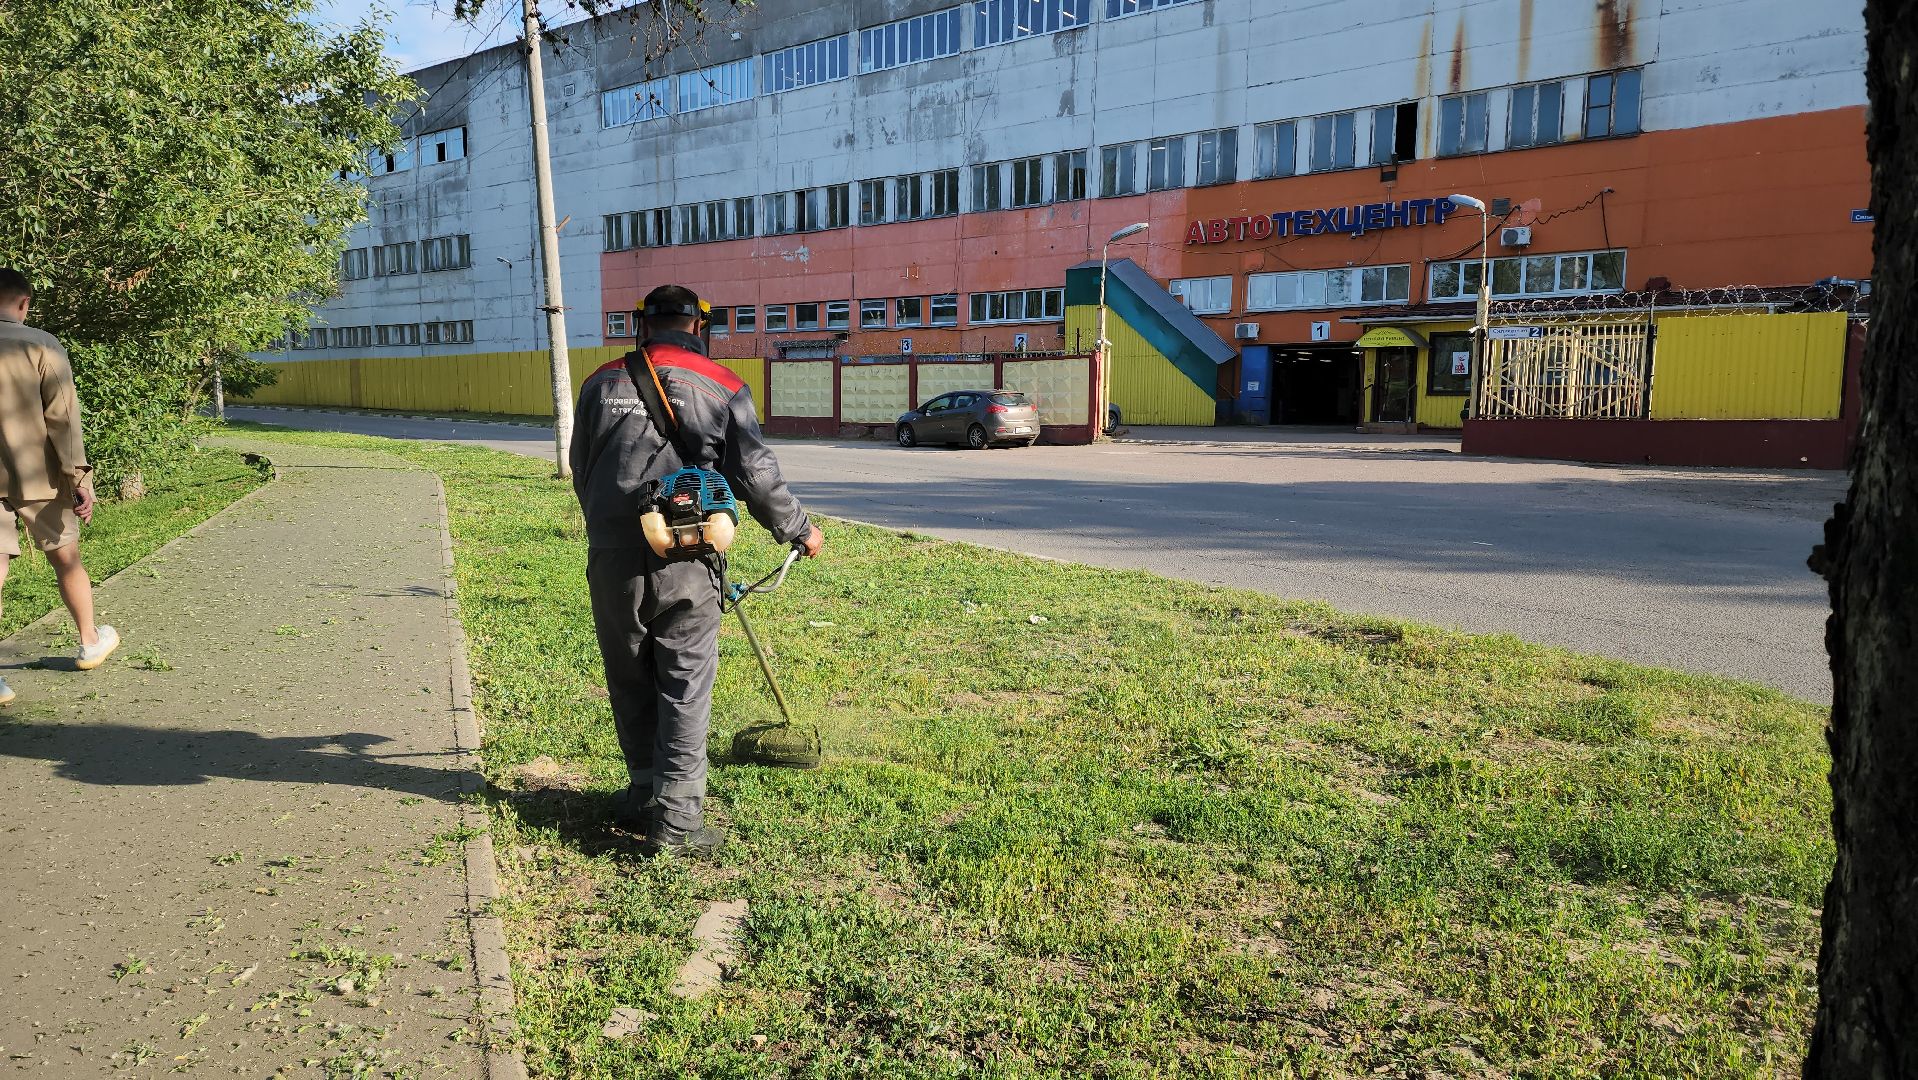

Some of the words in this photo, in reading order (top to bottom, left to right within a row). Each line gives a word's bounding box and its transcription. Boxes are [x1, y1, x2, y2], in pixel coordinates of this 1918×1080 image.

[1184, 196, 1459, 246] АВТОТЕХЦЕНТР
[1316, 325, 1323, 338] 1
[1530, 327, 1540, 337] 2
[903, 340, 910, 351] 3
